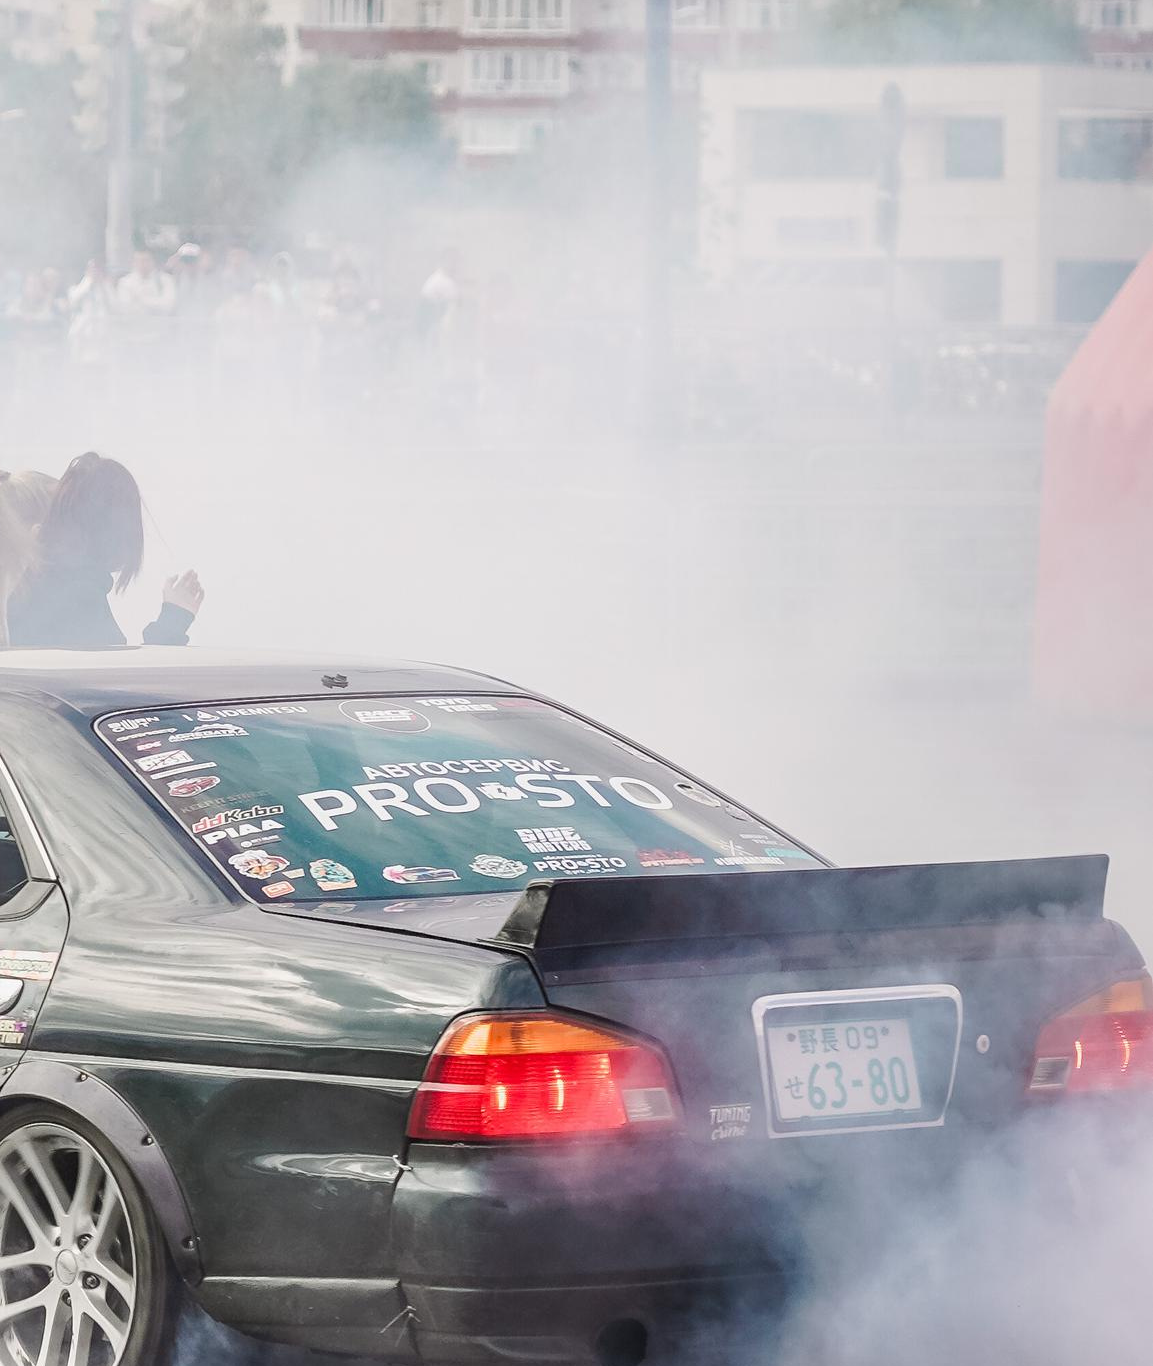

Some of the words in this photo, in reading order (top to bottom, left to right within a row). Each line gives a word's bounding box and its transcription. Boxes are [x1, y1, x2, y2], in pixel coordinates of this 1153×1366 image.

[215, 705, 308, 718] IDEMITSU
[416, 698, 471, 708] TOYO
[438, 704, 498, 714] TIRES
[361, 759, 570, 781] АВТОСЕРВИС
[192, 804, 285, 834] ddKaba
[201, 819, 286, 845] PIAA
[807, 1056, 911, 1110] 63-80
